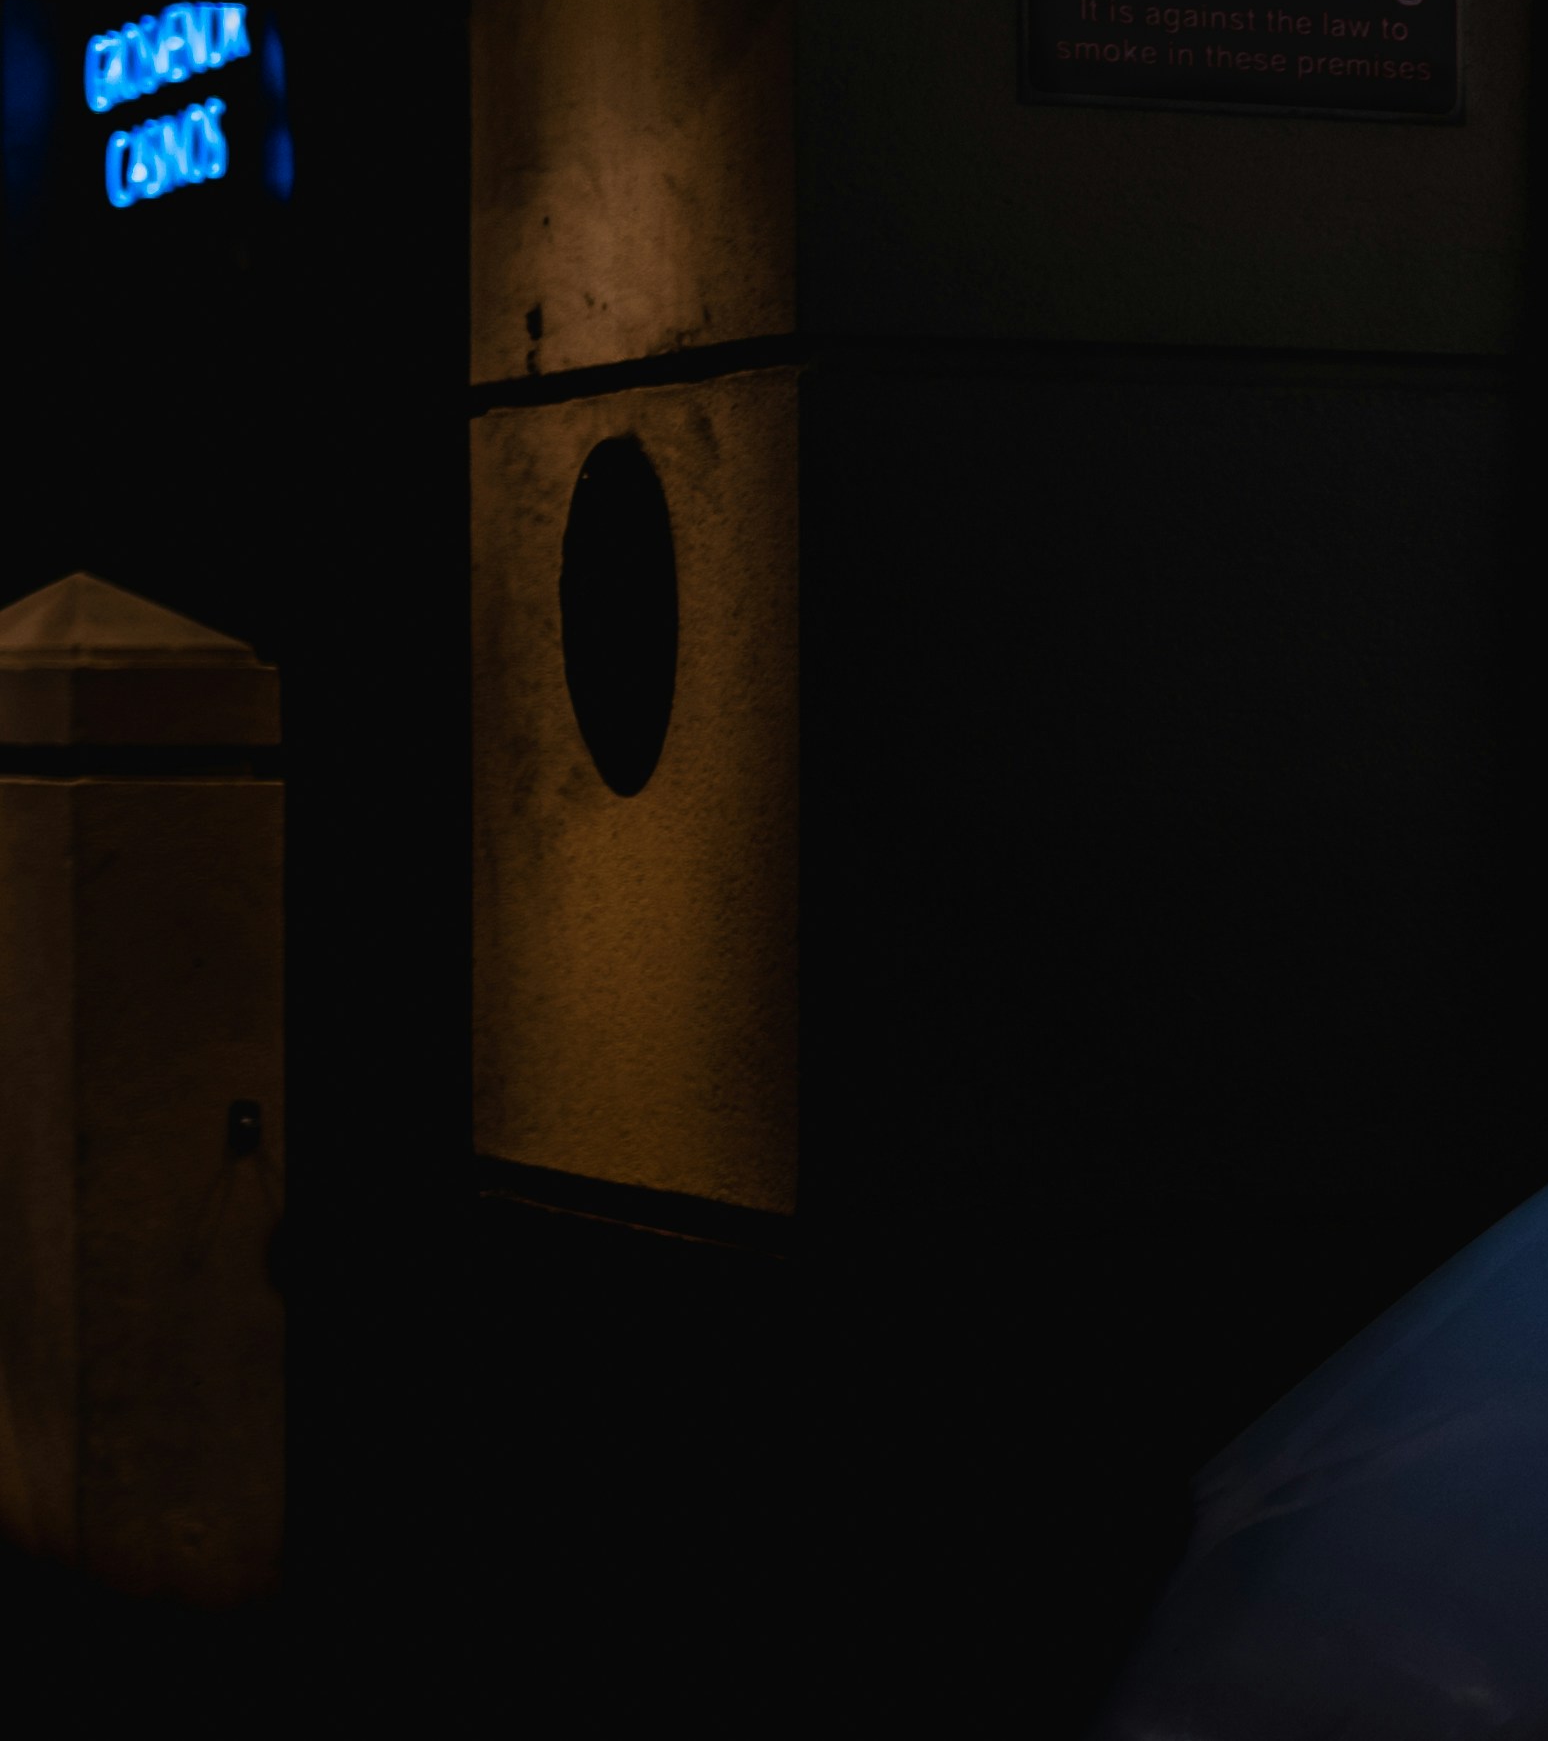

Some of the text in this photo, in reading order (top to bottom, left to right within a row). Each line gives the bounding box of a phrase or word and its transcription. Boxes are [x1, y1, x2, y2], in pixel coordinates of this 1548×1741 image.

[1145, 2, 1257, 36] against
[1266, 9, 1313, 36] the
[1323, 11, 1372, 39] law
[1381, 17, 1410, 42] to
[1056, 39, 1432, 82] smoke in these premises
